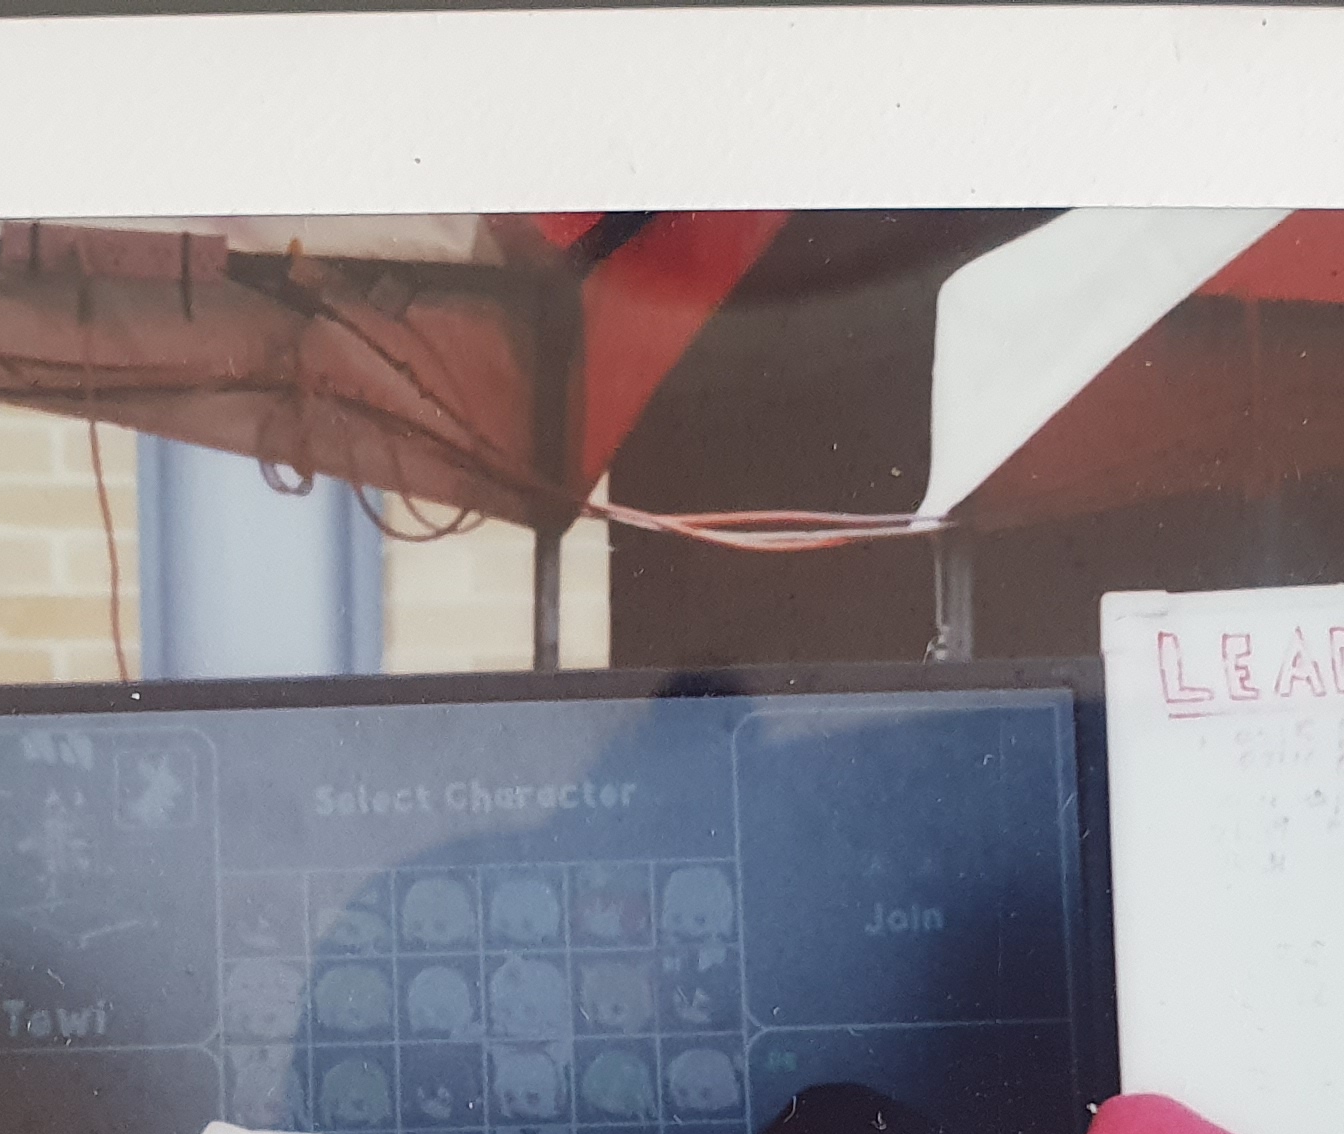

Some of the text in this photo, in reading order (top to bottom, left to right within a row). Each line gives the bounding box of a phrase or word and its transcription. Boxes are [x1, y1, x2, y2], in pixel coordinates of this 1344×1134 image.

[314, 778, 637, 816] Select Character
[864, 902, 946, 935] Join
